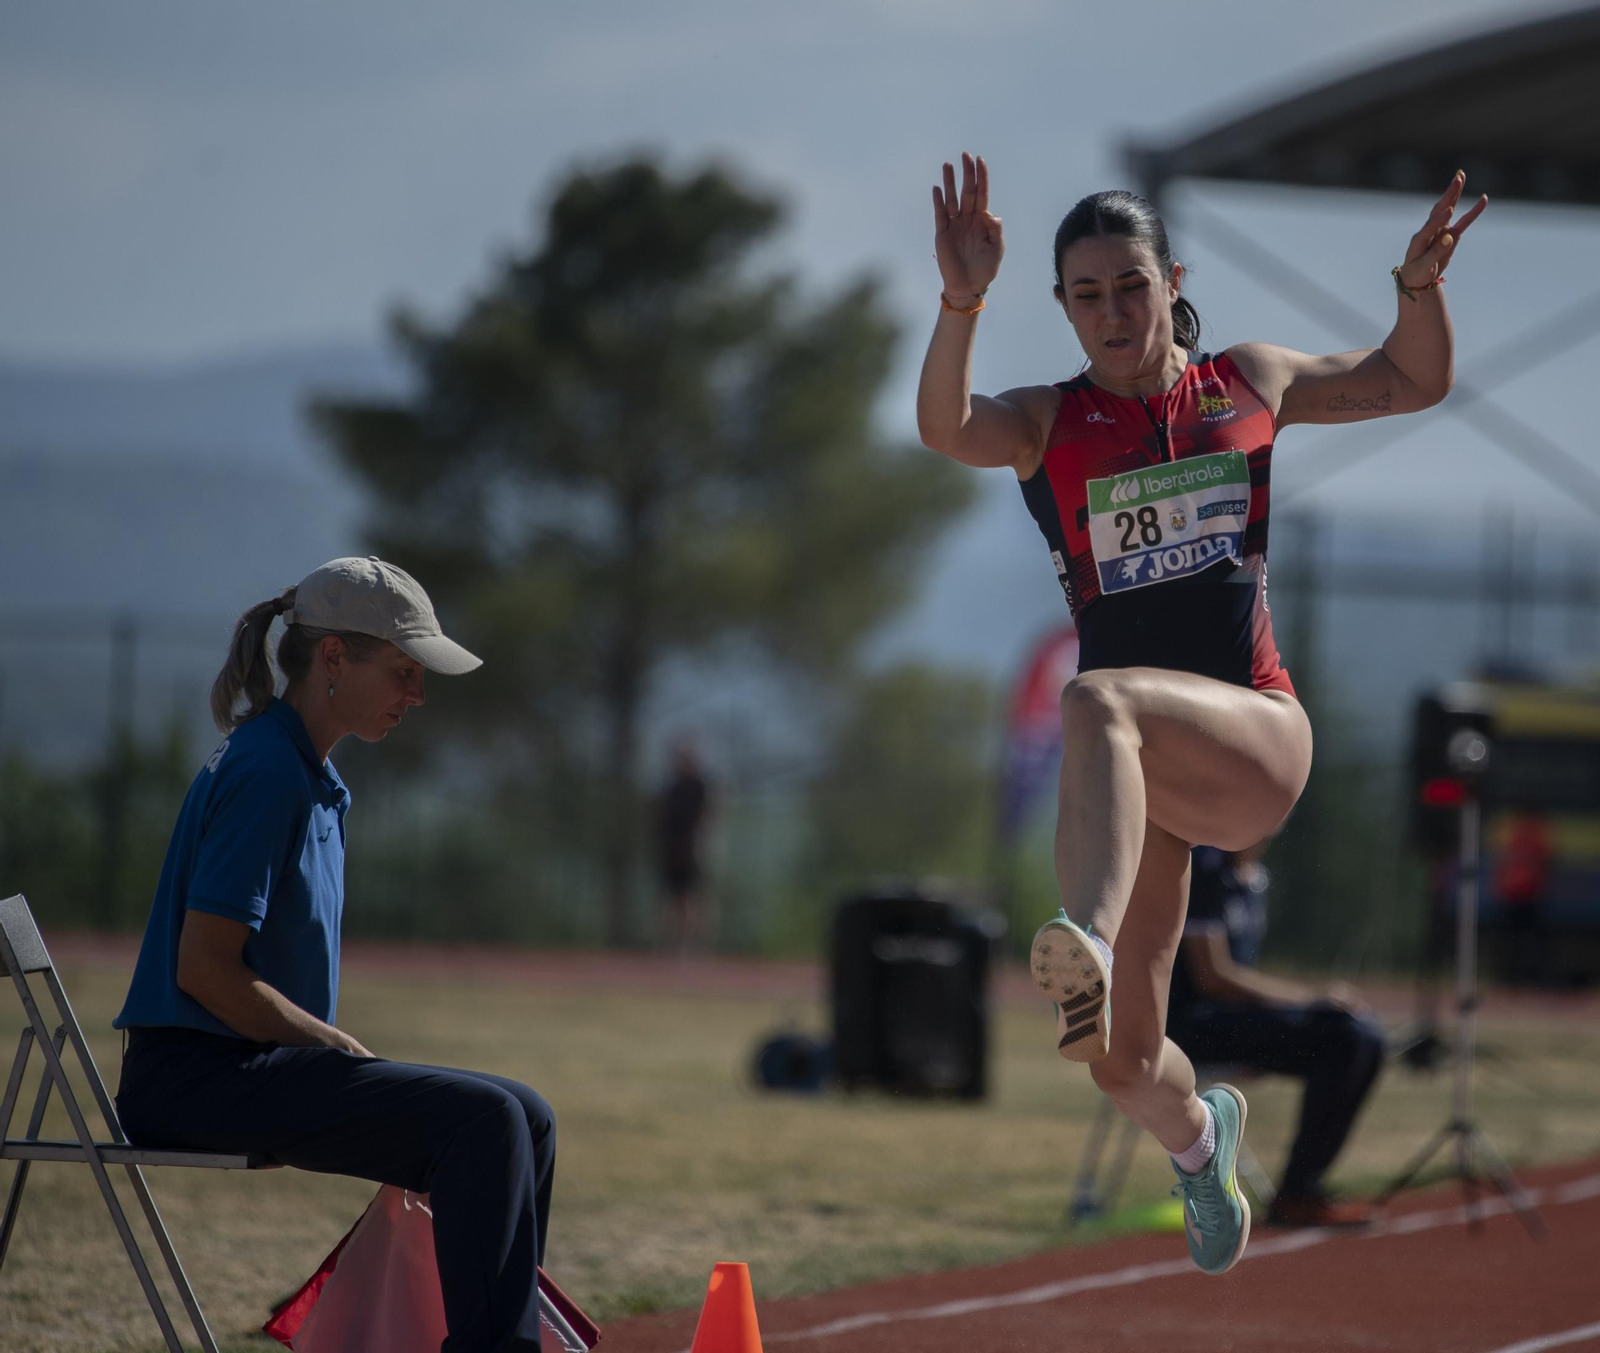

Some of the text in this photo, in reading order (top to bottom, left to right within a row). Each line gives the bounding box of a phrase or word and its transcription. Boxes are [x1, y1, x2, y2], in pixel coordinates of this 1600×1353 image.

[1143, 464, 1224, 495] Iberdrola
[1199, 503, 1247, 518] sanysec
[1114, 505, 1163, 553] 28
